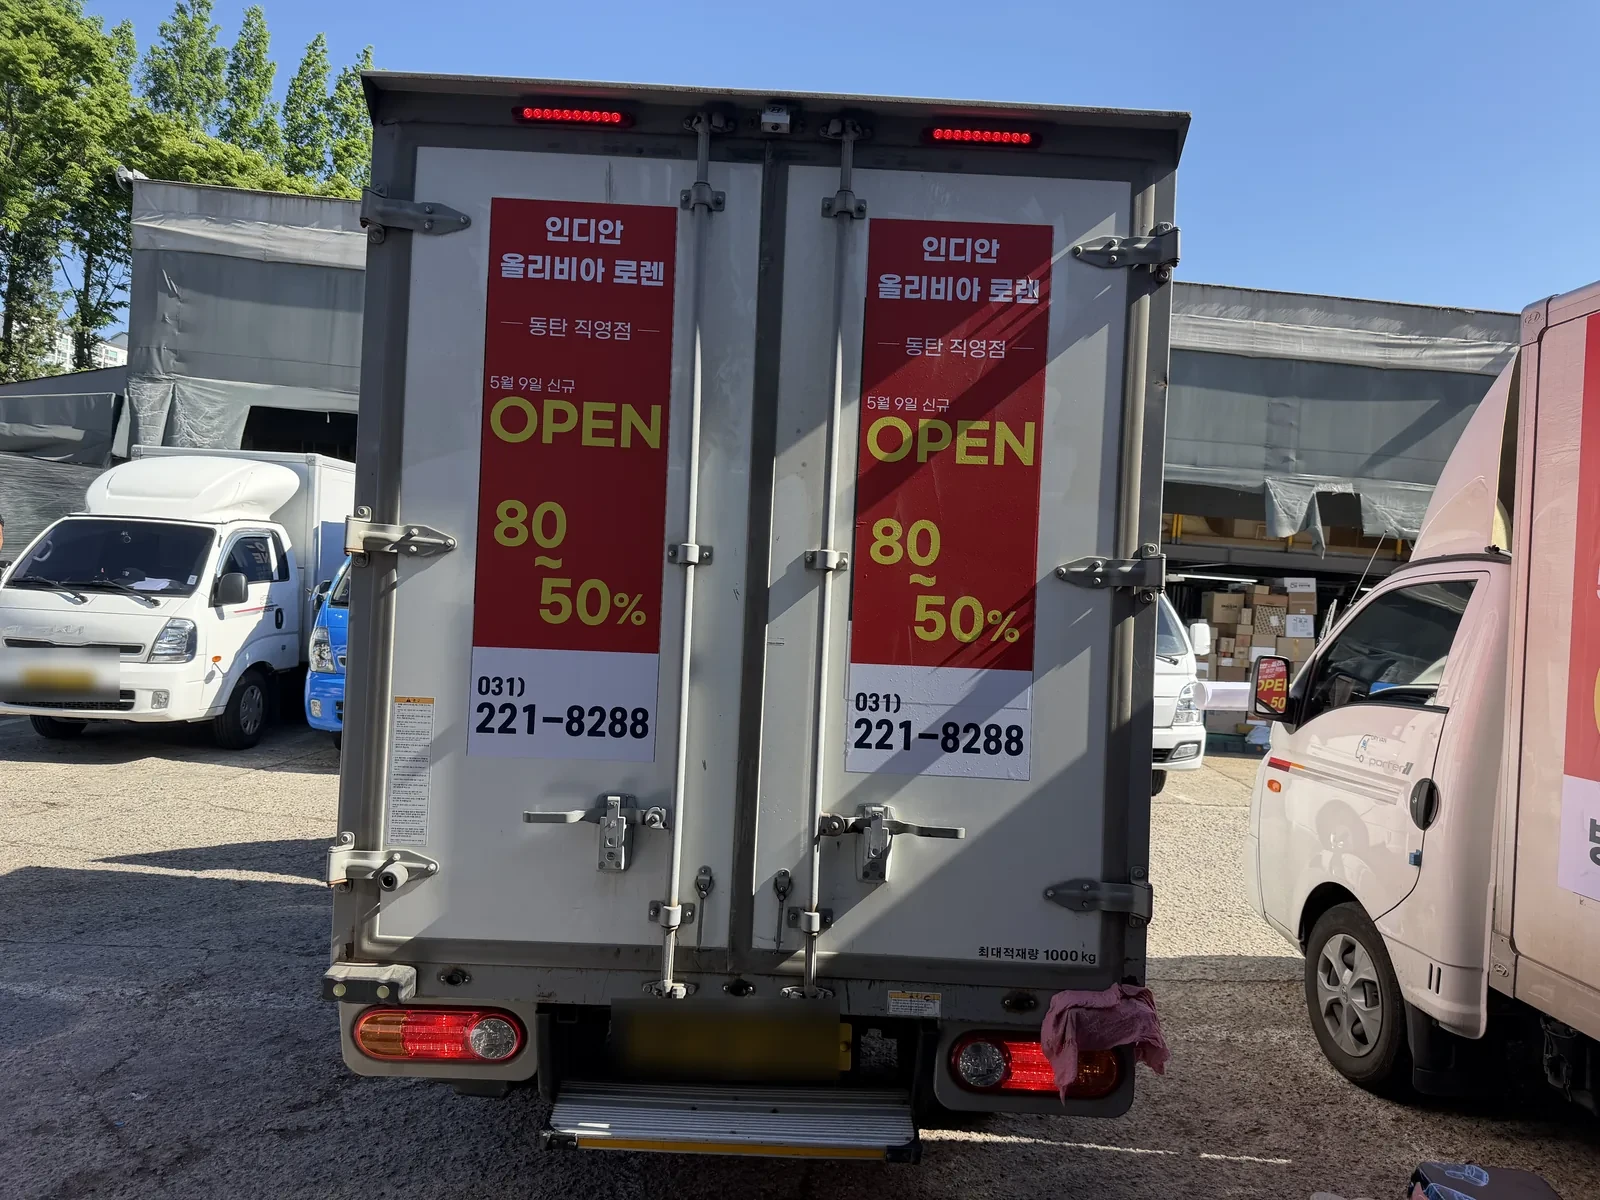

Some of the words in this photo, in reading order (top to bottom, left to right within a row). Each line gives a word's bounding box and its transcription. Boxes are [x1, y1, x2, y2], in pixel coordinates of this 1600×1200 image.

[545, 216, 624, 245] 인디안
[922, 236, 1001, 264] 인디안
[500, 252, 605, 283] 올리비아
[613, 259, 664, 287] 로렌
[878, 273, 981, 302] 올리비아
[988, 278, 1040, 305] 로렌
[529, 316, 568, 337] 동탄
[574, 319, 631, 341] 직영점
[905, 337, 943, 357] 동탄
[949, 339, 1006, 359] 직영점
[490, 375, 514, 390] 5월
[518, 377, 542, 392] 9일
[547, 378, 576, 394] 신규
[866, 396, 890, 410] 5월
[894, 397, 917, 412] 9일
[922, 398, 950, 413] 신규
[490, 396, 662, 449] OPEN
[866, 416, 1035, 466] OPEN
[493, 499, 567, 549] 80
[869, 517, 941, 567] 80
[538, 577, 647, 626] 50%
[913, 595, 1020, 643] 50%
[477, 675, 525, 697] 031)
[1258, 678, 1287, 692] OPE
[855, 692, 901, 714] 031)
[475, 701, 649, 739] 221-8288
[853, 718, 1024, 756] 221-8288
[978, 946, 1039, 961] 최대적재량
[1043, 949, 1078, 962] 1000
[1081, 950, 1096, 965] kg
